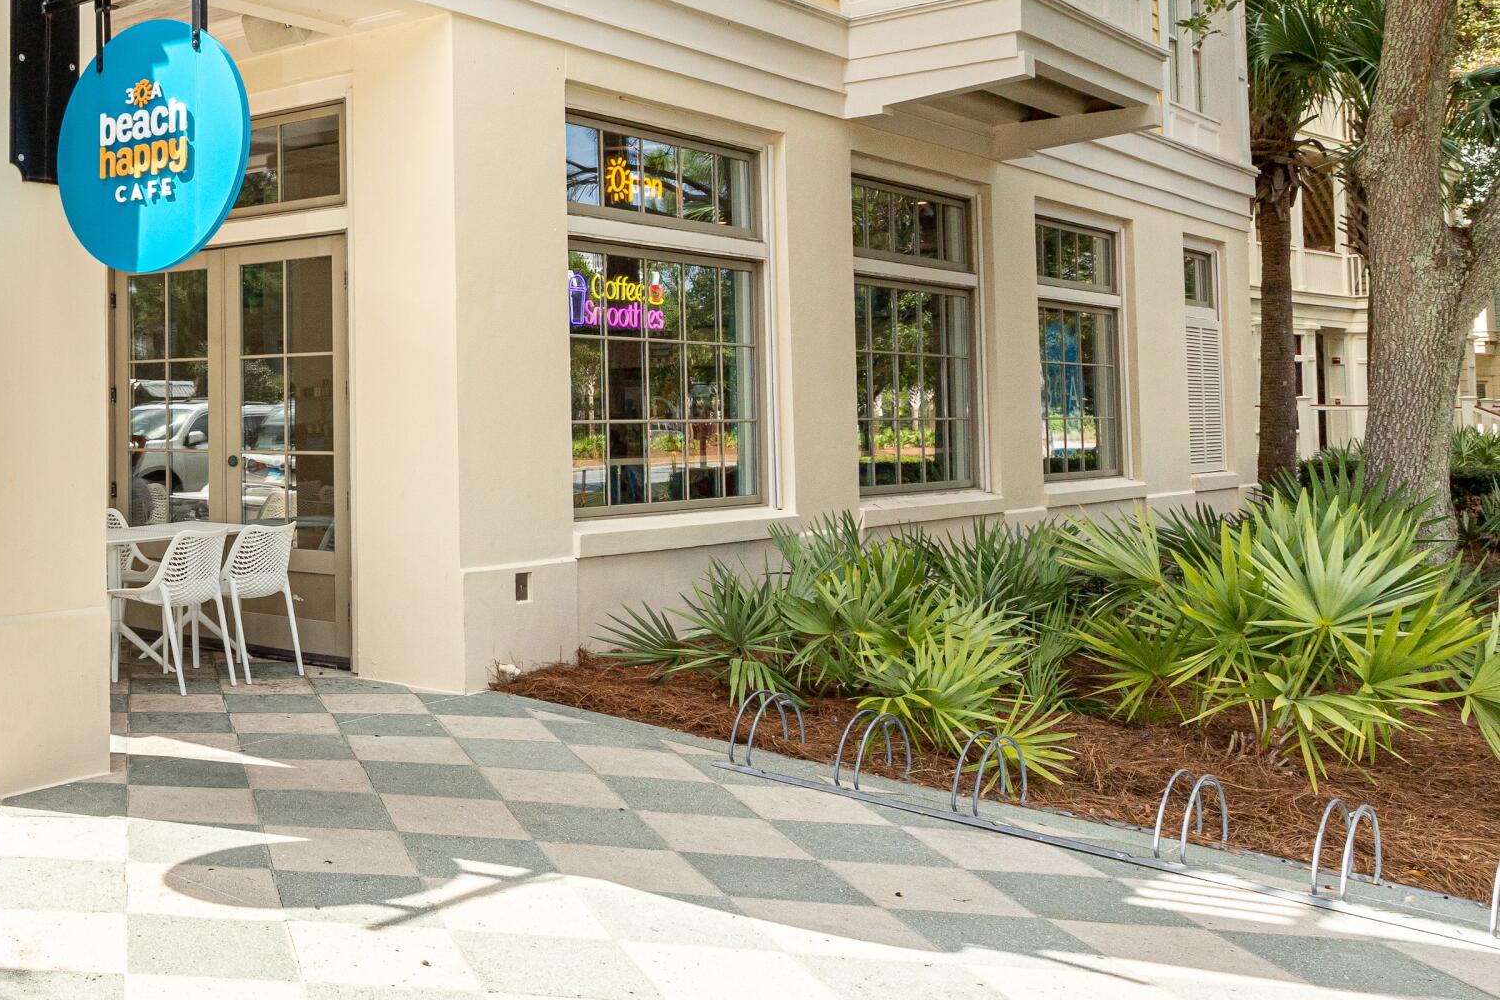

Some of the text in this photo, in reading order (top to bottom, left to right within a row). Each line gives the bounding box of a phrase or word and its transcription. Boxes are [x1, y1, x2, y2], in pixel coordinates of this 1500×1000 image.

[100, 97, 187, 147] beach
[100, 136, 187, 179] happy
[115, 178, 172, 202] CAFE
[591, 273, 646, 301] Coffee
